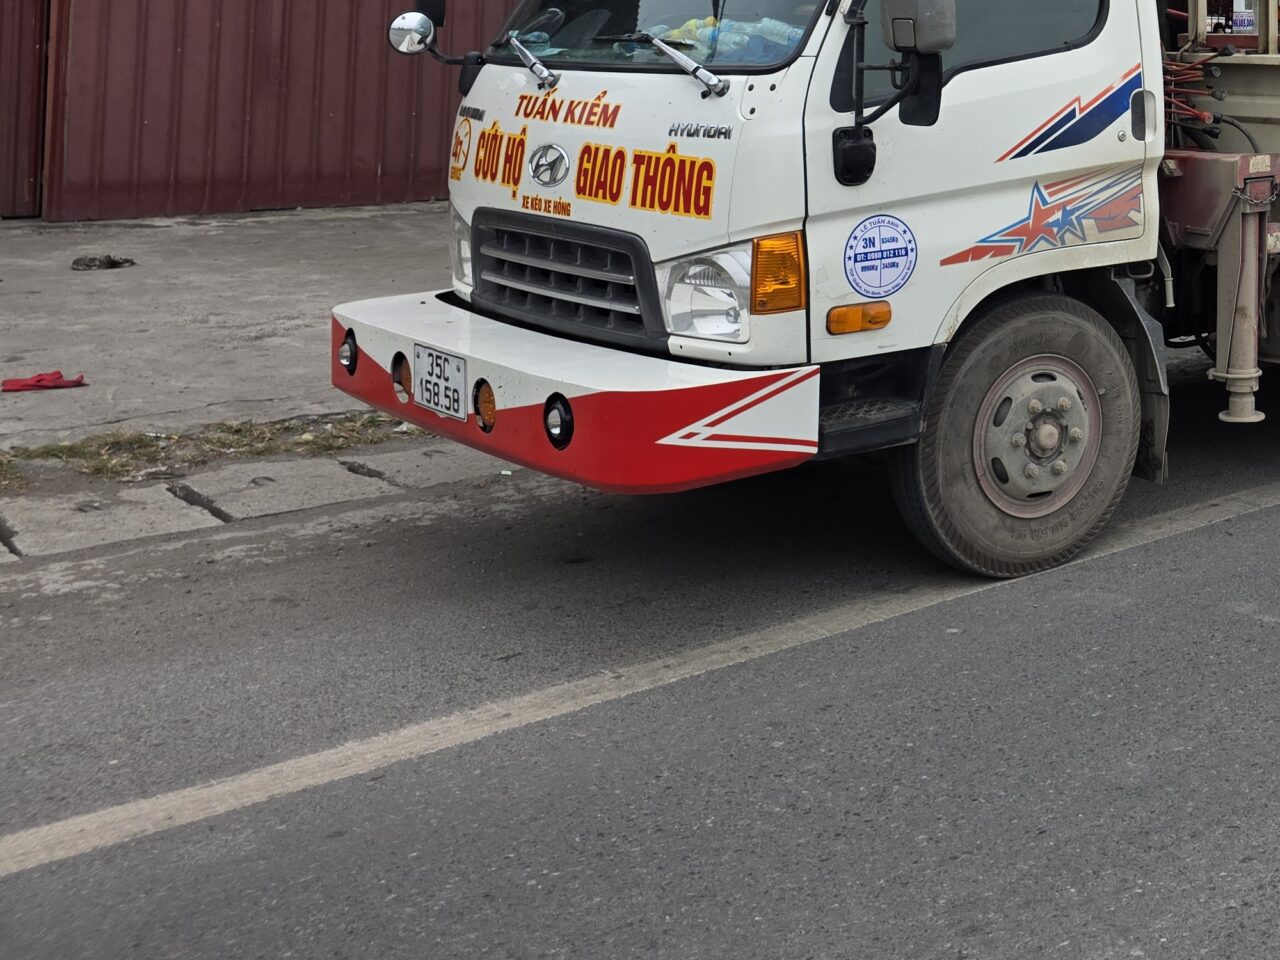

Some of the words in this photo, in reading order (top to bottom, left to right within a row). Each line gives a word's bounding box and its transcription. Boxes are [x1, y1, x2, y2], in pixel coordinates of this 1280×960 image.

[515, 87, 563, 122] TUẤN
[668, 123, 734, 140] HYUNDAI
[474, 121, 504, 182] CỨU
[501, 127, 527, 198] HỘ
[576, 143, 626, 203] GIAO
[630, 143, 715, 217] THÔNG
[522, 195, 529, 209] XE
[531, 194, 543, 212] KÉO
[543, 199, 551, 214] XE
[862, 236, 876, 249] 3N
[883, 249, 894, 258] 812
[427, 352, 450, 383] 35C
[420, 377, 460, 414] 158.58
